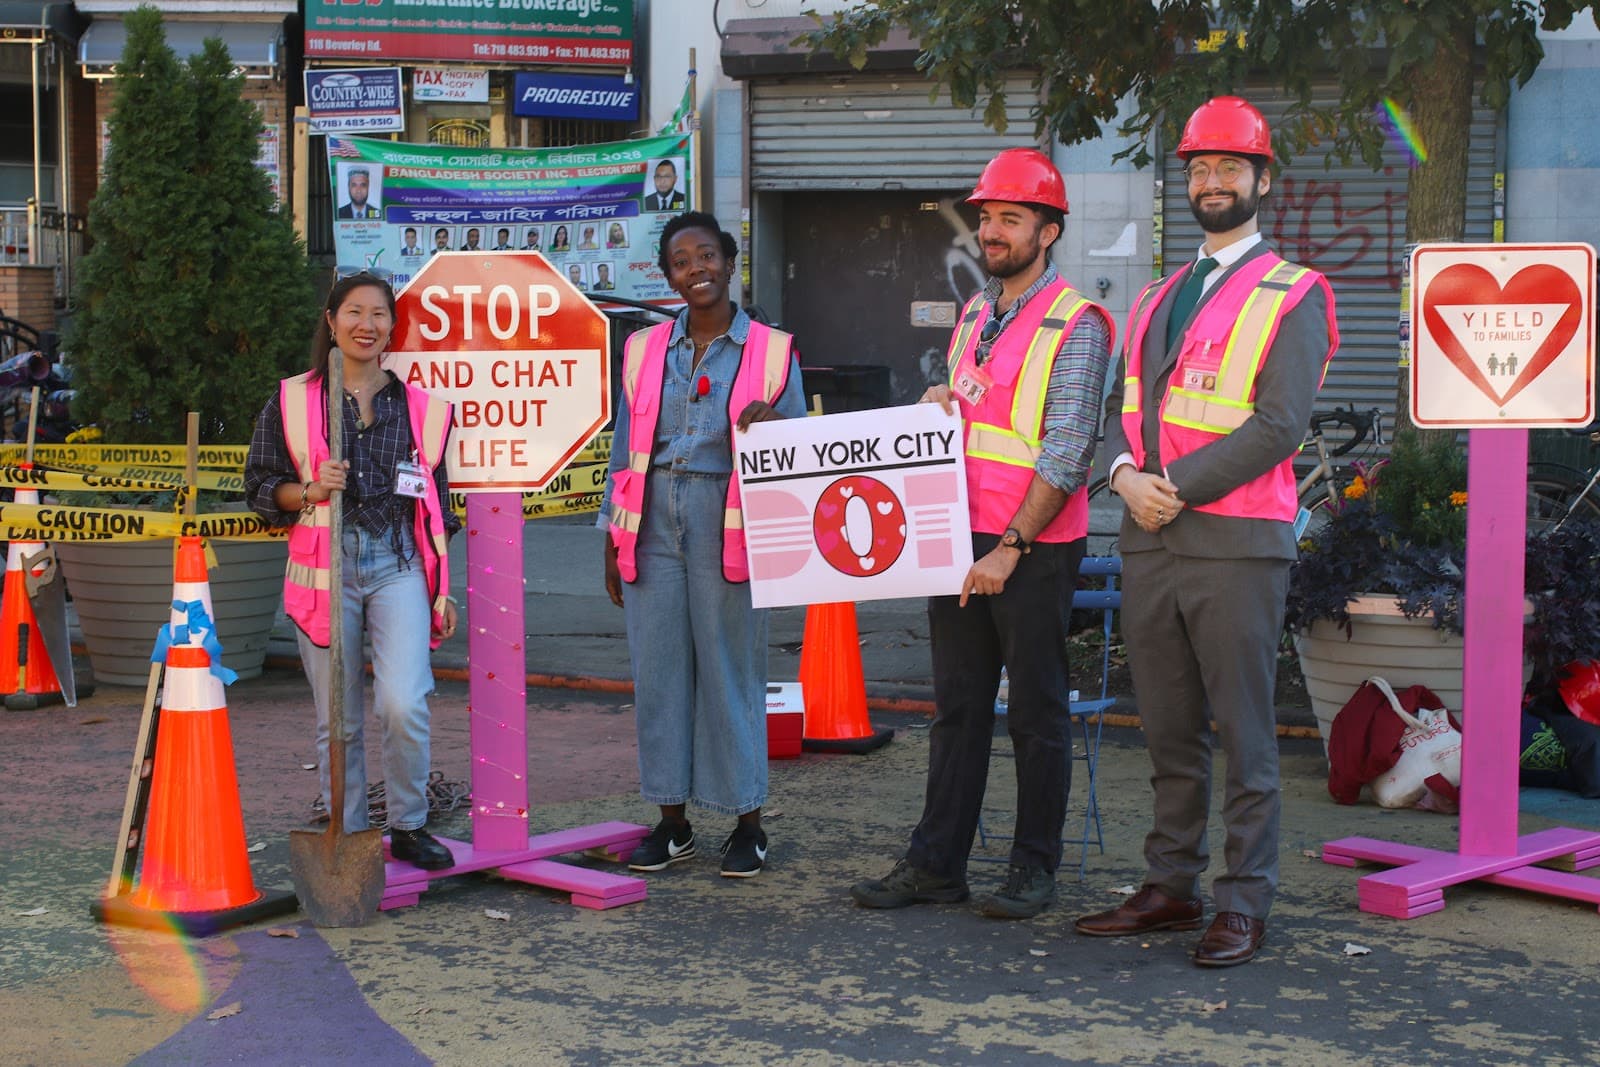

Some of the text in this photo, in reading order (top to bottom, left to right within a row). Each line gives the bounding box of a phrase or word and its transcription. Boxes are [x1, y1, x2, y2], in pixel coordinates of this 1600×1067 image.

[412, 70, 486, 85] TAX NOTARY
[312, 99, 395, 110] INSURANCE COMPANY
[522, 87, 634, 107] PROGRESSIVE
[389, 167, 481, 180] BANGLADESH
[484, 170, 542, 181] SOCIETY
[578, 166, 620, 177] ELECTION
[419, 284, 561, 341] STOP
[1463, 311, 1544, 328] YIELD
[1474, 331, 1532, 342] TO FAMILIES
[407, 360, 577, 389] AND CHAT
[452, 400, 547, 428] BOUT
[459, 439, 528, 468] LIFE
[740, 429, 955, 475] NEW YORK CITY
[37, 509, 145, 535] CAUTION
